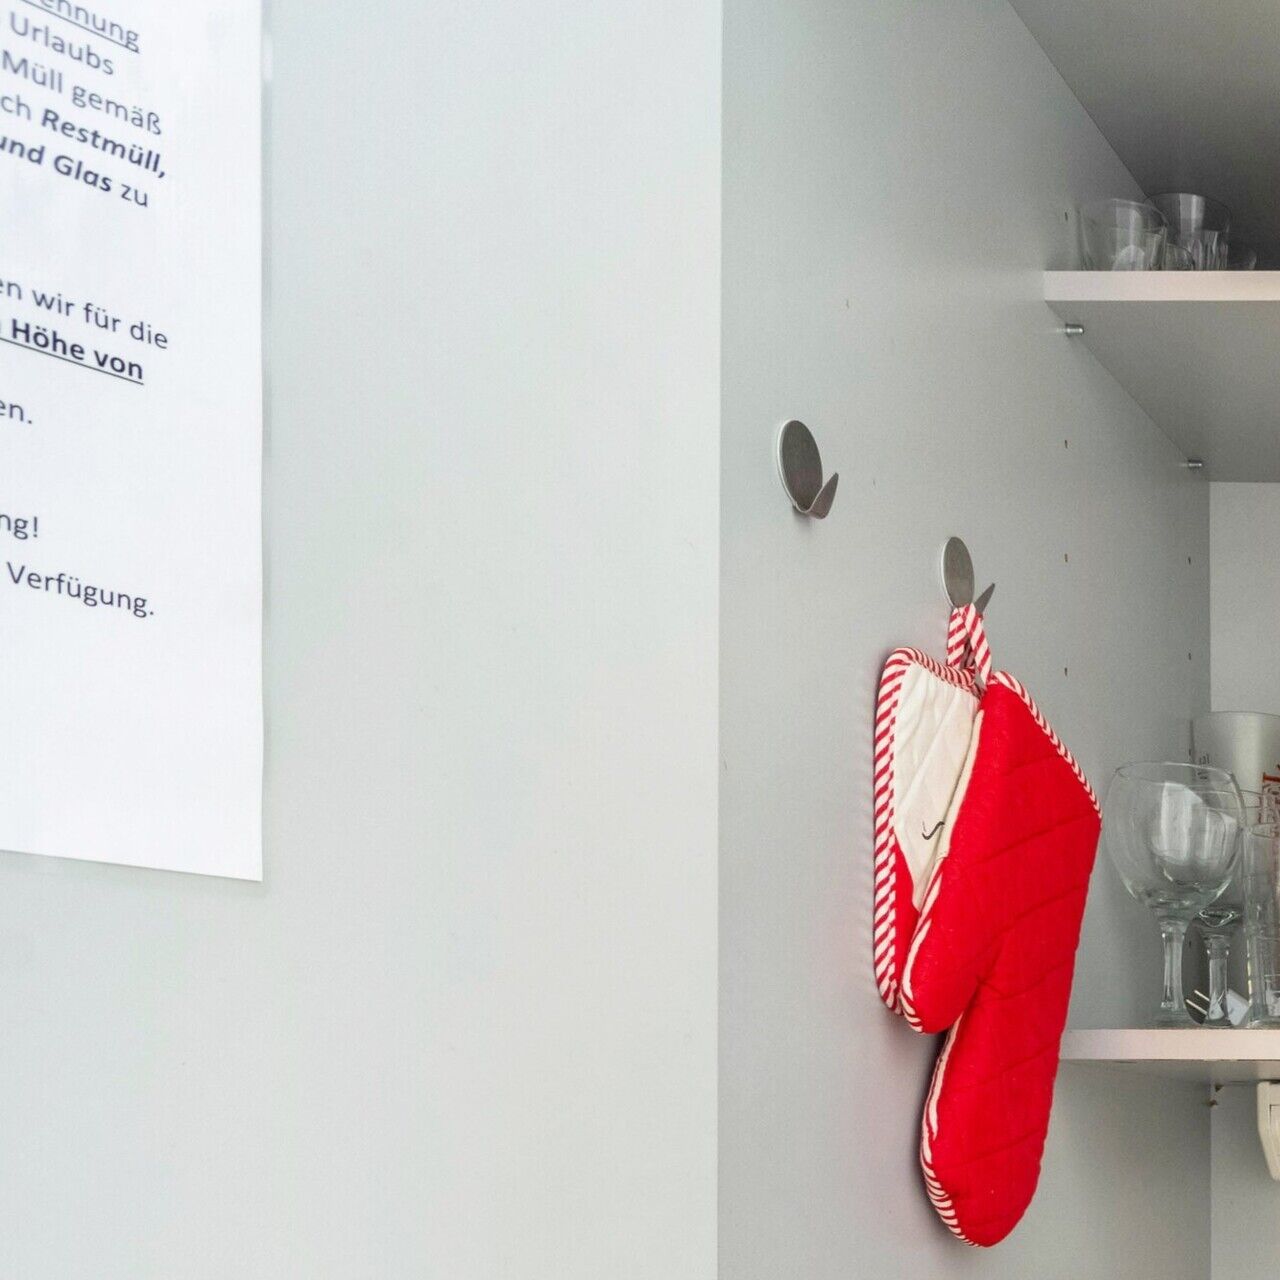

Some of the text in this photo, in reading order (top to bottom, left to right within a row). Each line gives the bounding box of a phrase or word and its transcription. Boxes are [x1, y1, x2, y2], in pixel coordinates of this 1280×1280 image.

[10, 11, 114, 75] Urlaubs
[2, 49, 162, 135] Müll gemäß
[41, 108, 165, 178] Restmüll,
[53, 154, 113, 192] Glas
[120, 183, 149, 207] zu
[12, 318, 144, 382] Höhe von
[32, 289, 75, 317] wir
[83, 302, 121, 332] für
[130, 321, 168, 350] die
[7, 561, 154, 618] Verfügung.
